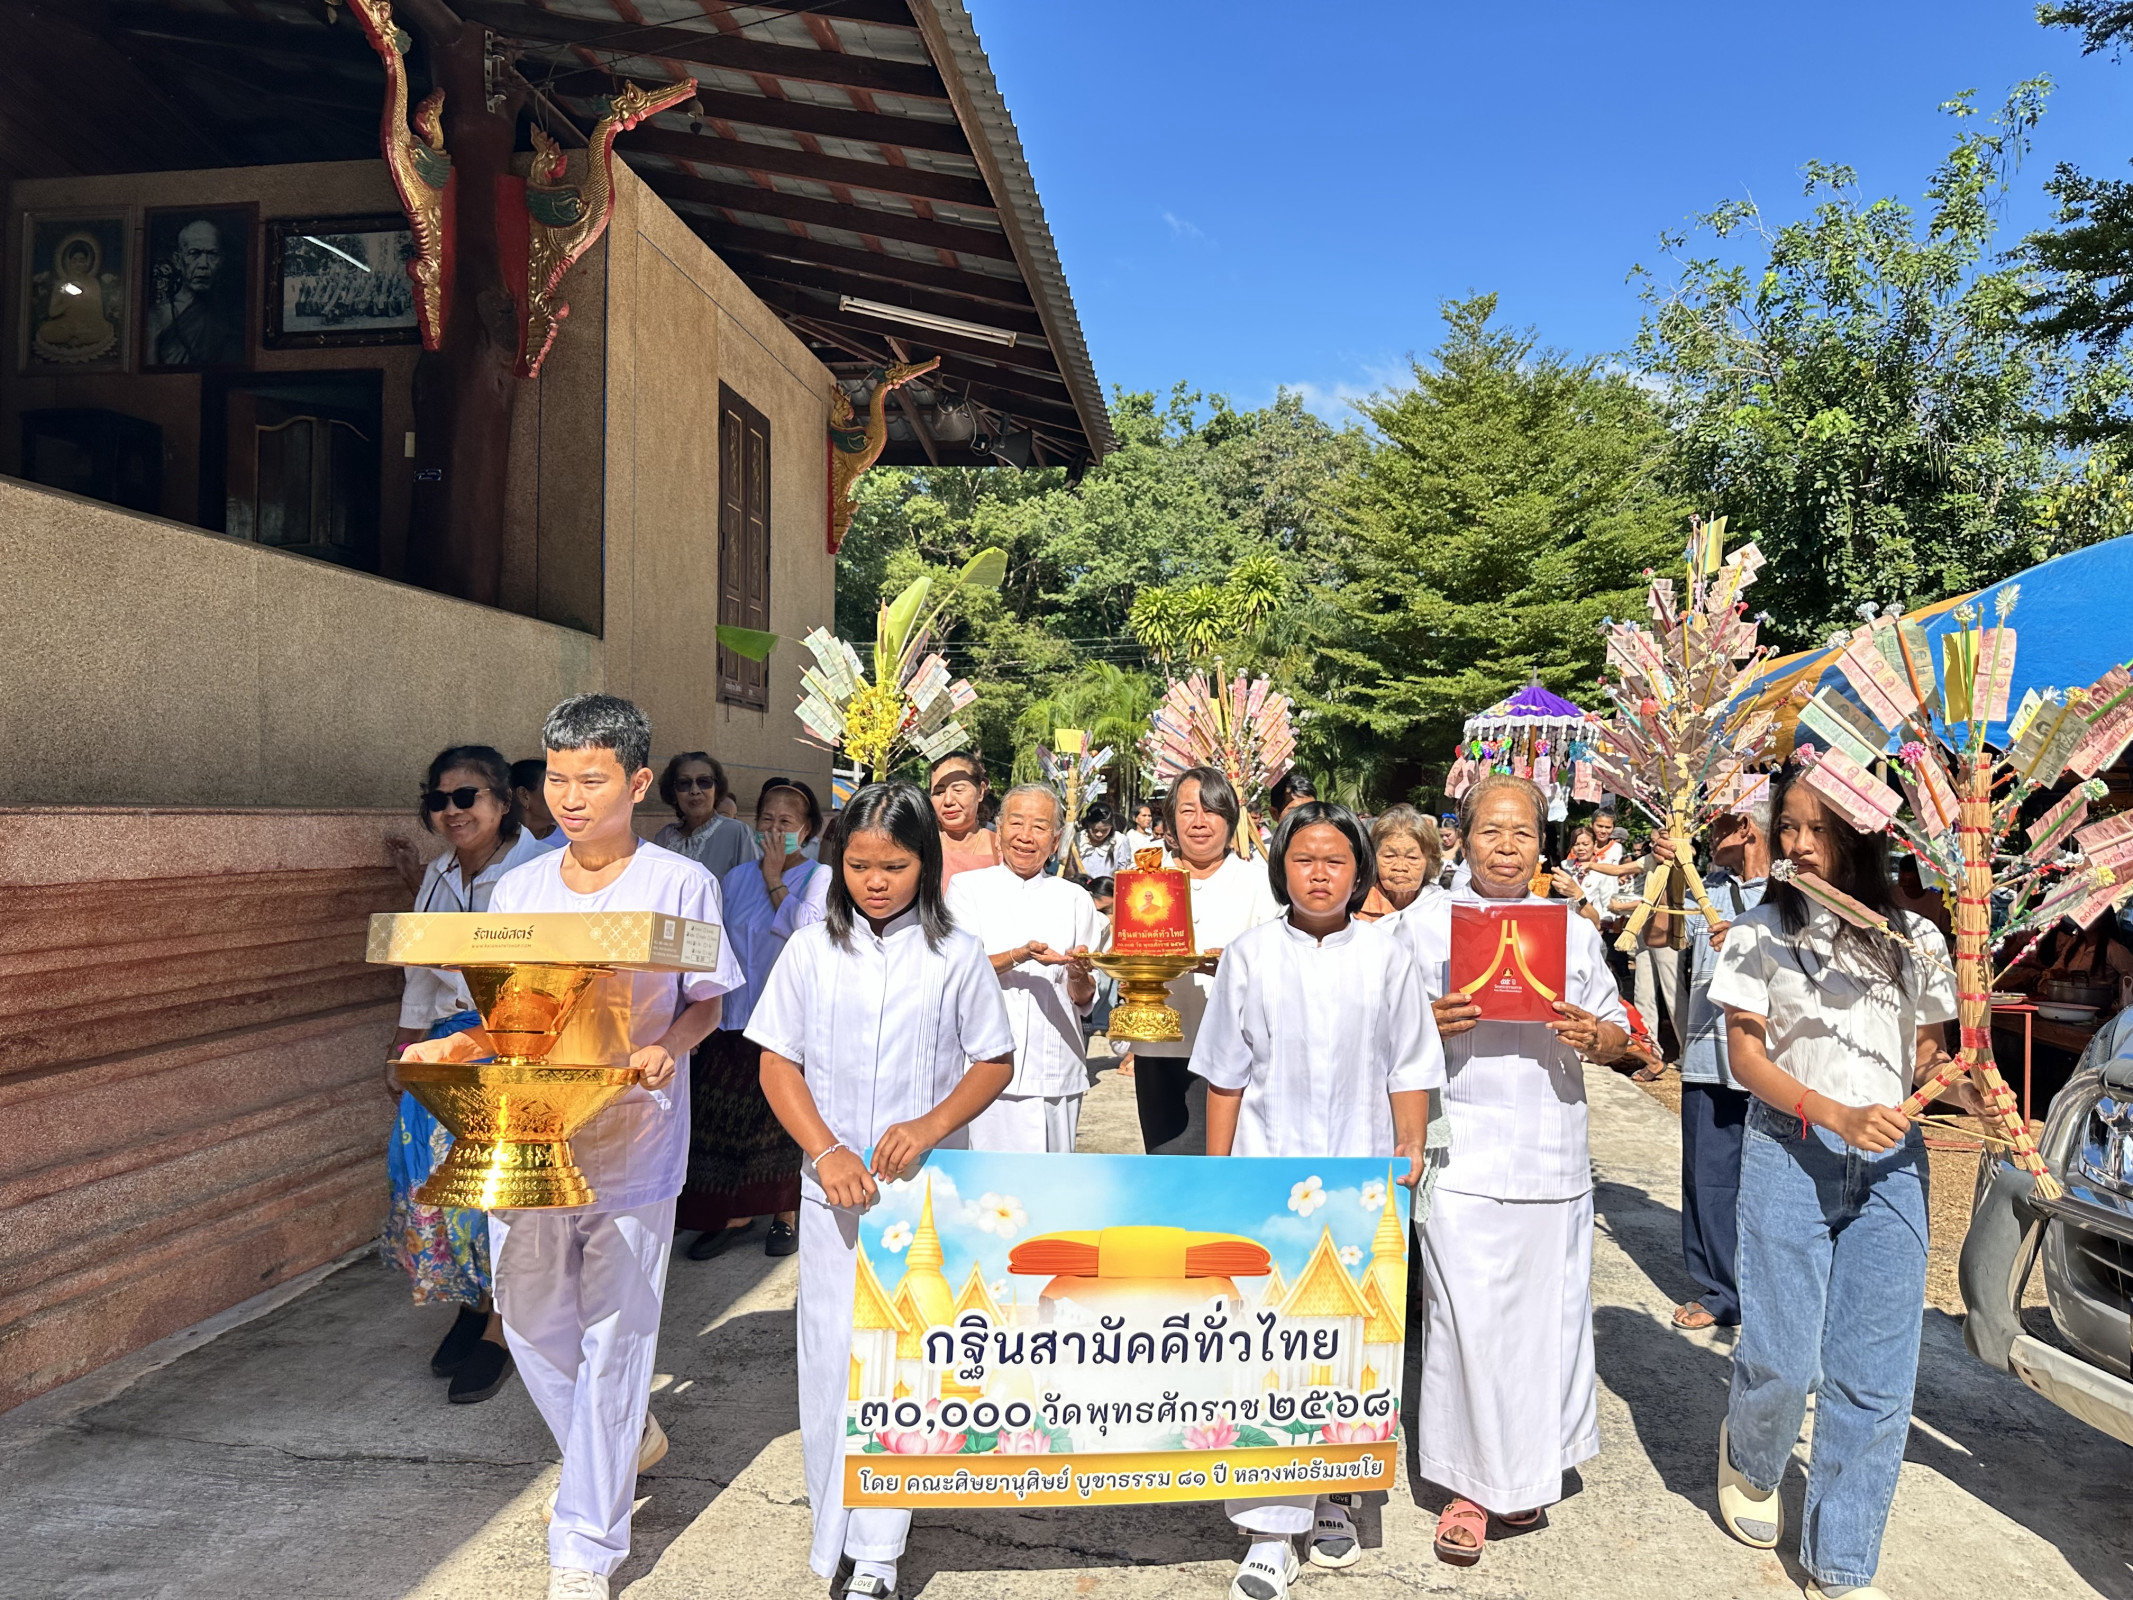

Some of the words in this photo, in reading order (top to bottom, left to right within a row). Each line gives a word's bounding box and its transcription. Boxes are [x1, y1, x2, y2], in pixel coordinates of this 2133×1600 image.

[473, 925, 535, 940] รัตนพัสตร์
[1117, 927, 1185, 941] กฐินสามัคคีทั่วไทย
[926, 1302, 1339, 1380] กฐินสามัคคีทั่วไทย
[861, 1402, 1032, 1434] ๓๐,๐๐๐
[1268, 1387, 1392, 1421] ๒๕๖๘
[859, 1468, 899, 1492] โดย
[907, 1466, 1070, 1498] คณะศิษยานุศิษย์
[1077, 1470, 1171, 1498] บูชาธรรม
[1178, 1473, 1207, 1487] ๘๑
[1214, 1462, 1228, 1485] ปี
[1234, 1458, 1384, 1484] หลวงพ่อธัมมชโย
[1331, 1494, 1350, 1503] LOVE
[853, 1579, 873, 1588] LOVE
